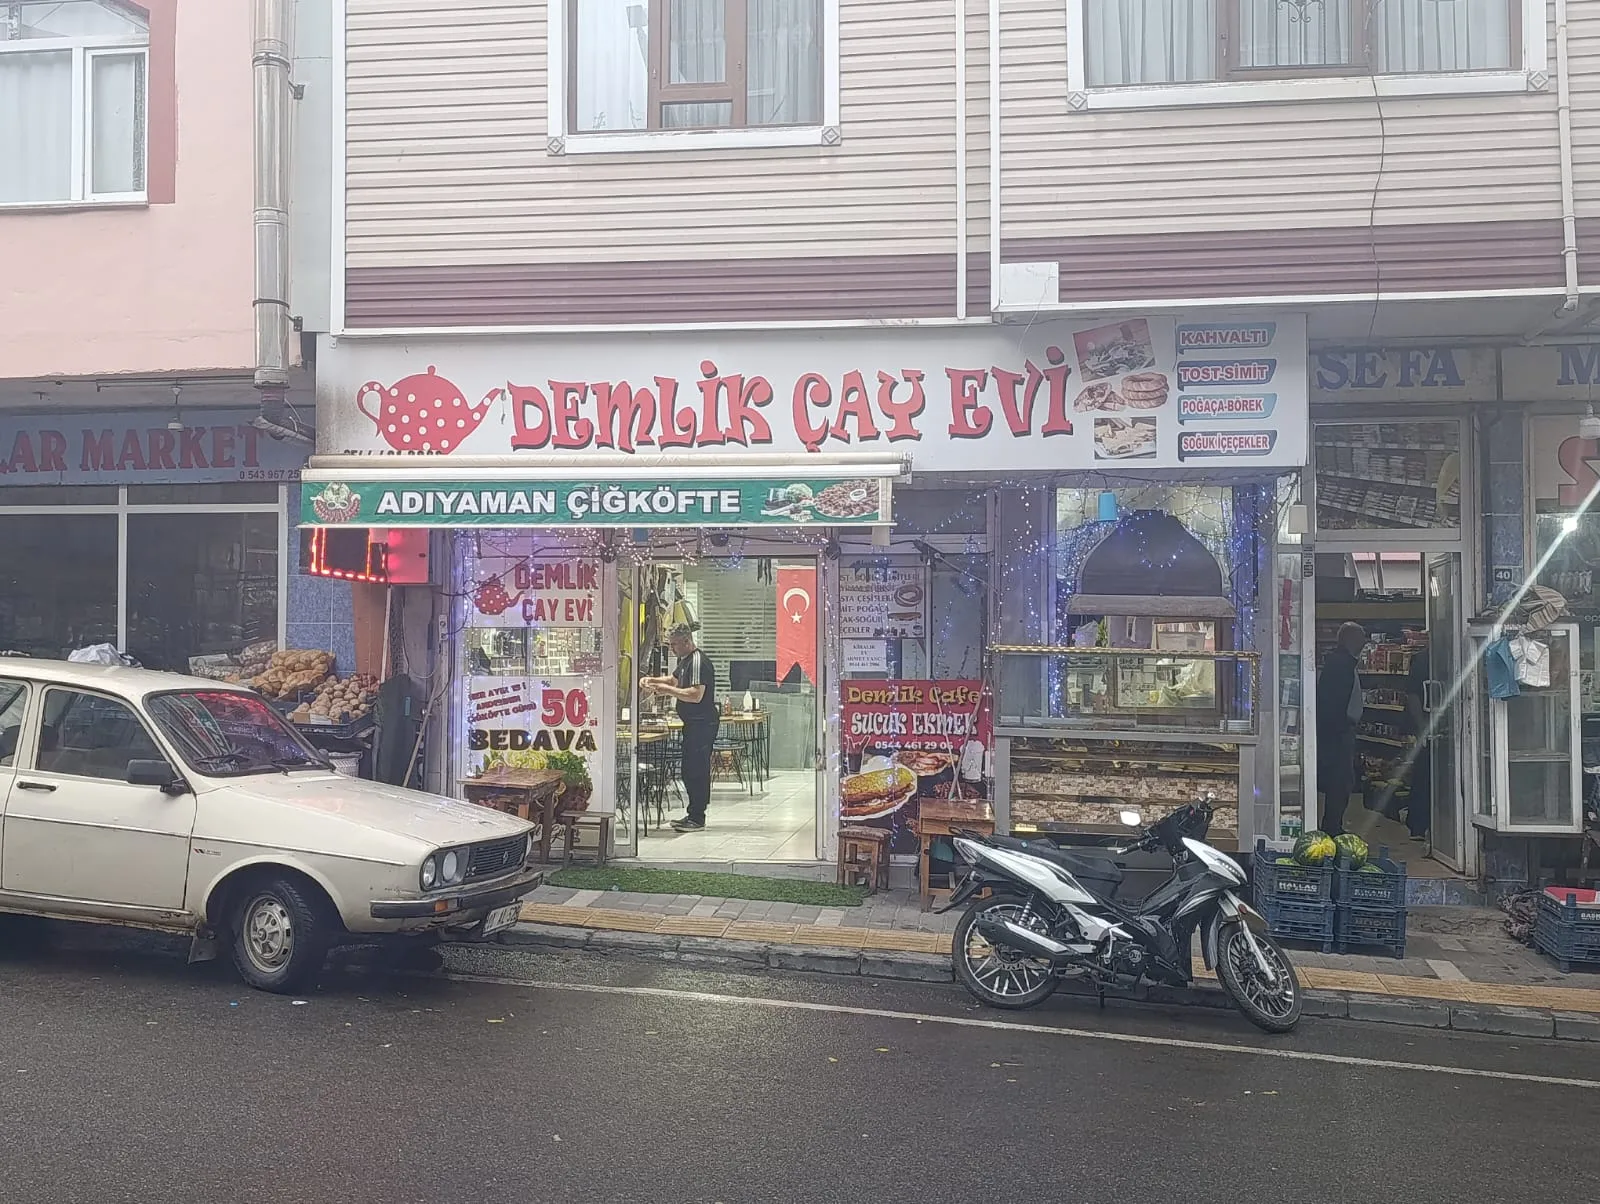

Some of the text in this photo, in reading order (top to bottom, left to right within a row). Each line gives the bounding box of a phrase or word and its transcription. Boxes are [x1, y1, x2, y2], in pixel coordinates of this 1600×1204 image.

[1180, 329, 1267, 345] KAHVALTI
[1179, 363, 1268, 381] TOST-SİMİT
[507, 345, 1075, 454] DEMLİK ÇAY EVİ
[1181, 396, 1264, 416] POĞAÇA-BÖREK
[79, 424, 265, 472] MARKET
[1182, 434, 1216, 450] SOĞUK
[239, 469, 246, 480] 0
[247, 469, 265, 480] 543
[376, 484, 742, 519] ADIYAMAN ÇİĞKÖFTE
[514, 559, 599, 590] DEMLİK
[1495, 571, 1511, 580] 40
[521, 593, 593, 626] ÇAY EVİ
[847, 685, 981, 705] Demlik Cafe
[541, 688, 589, 728] 50
[850, 711, 978, 736] SUCUK EKMEK
[468, 728, 598, 751] BEDAVA
[874, 740, 902, 750] 0544
[903, 740, 922, 750] 461
[924, 740, 938, 750] 29
